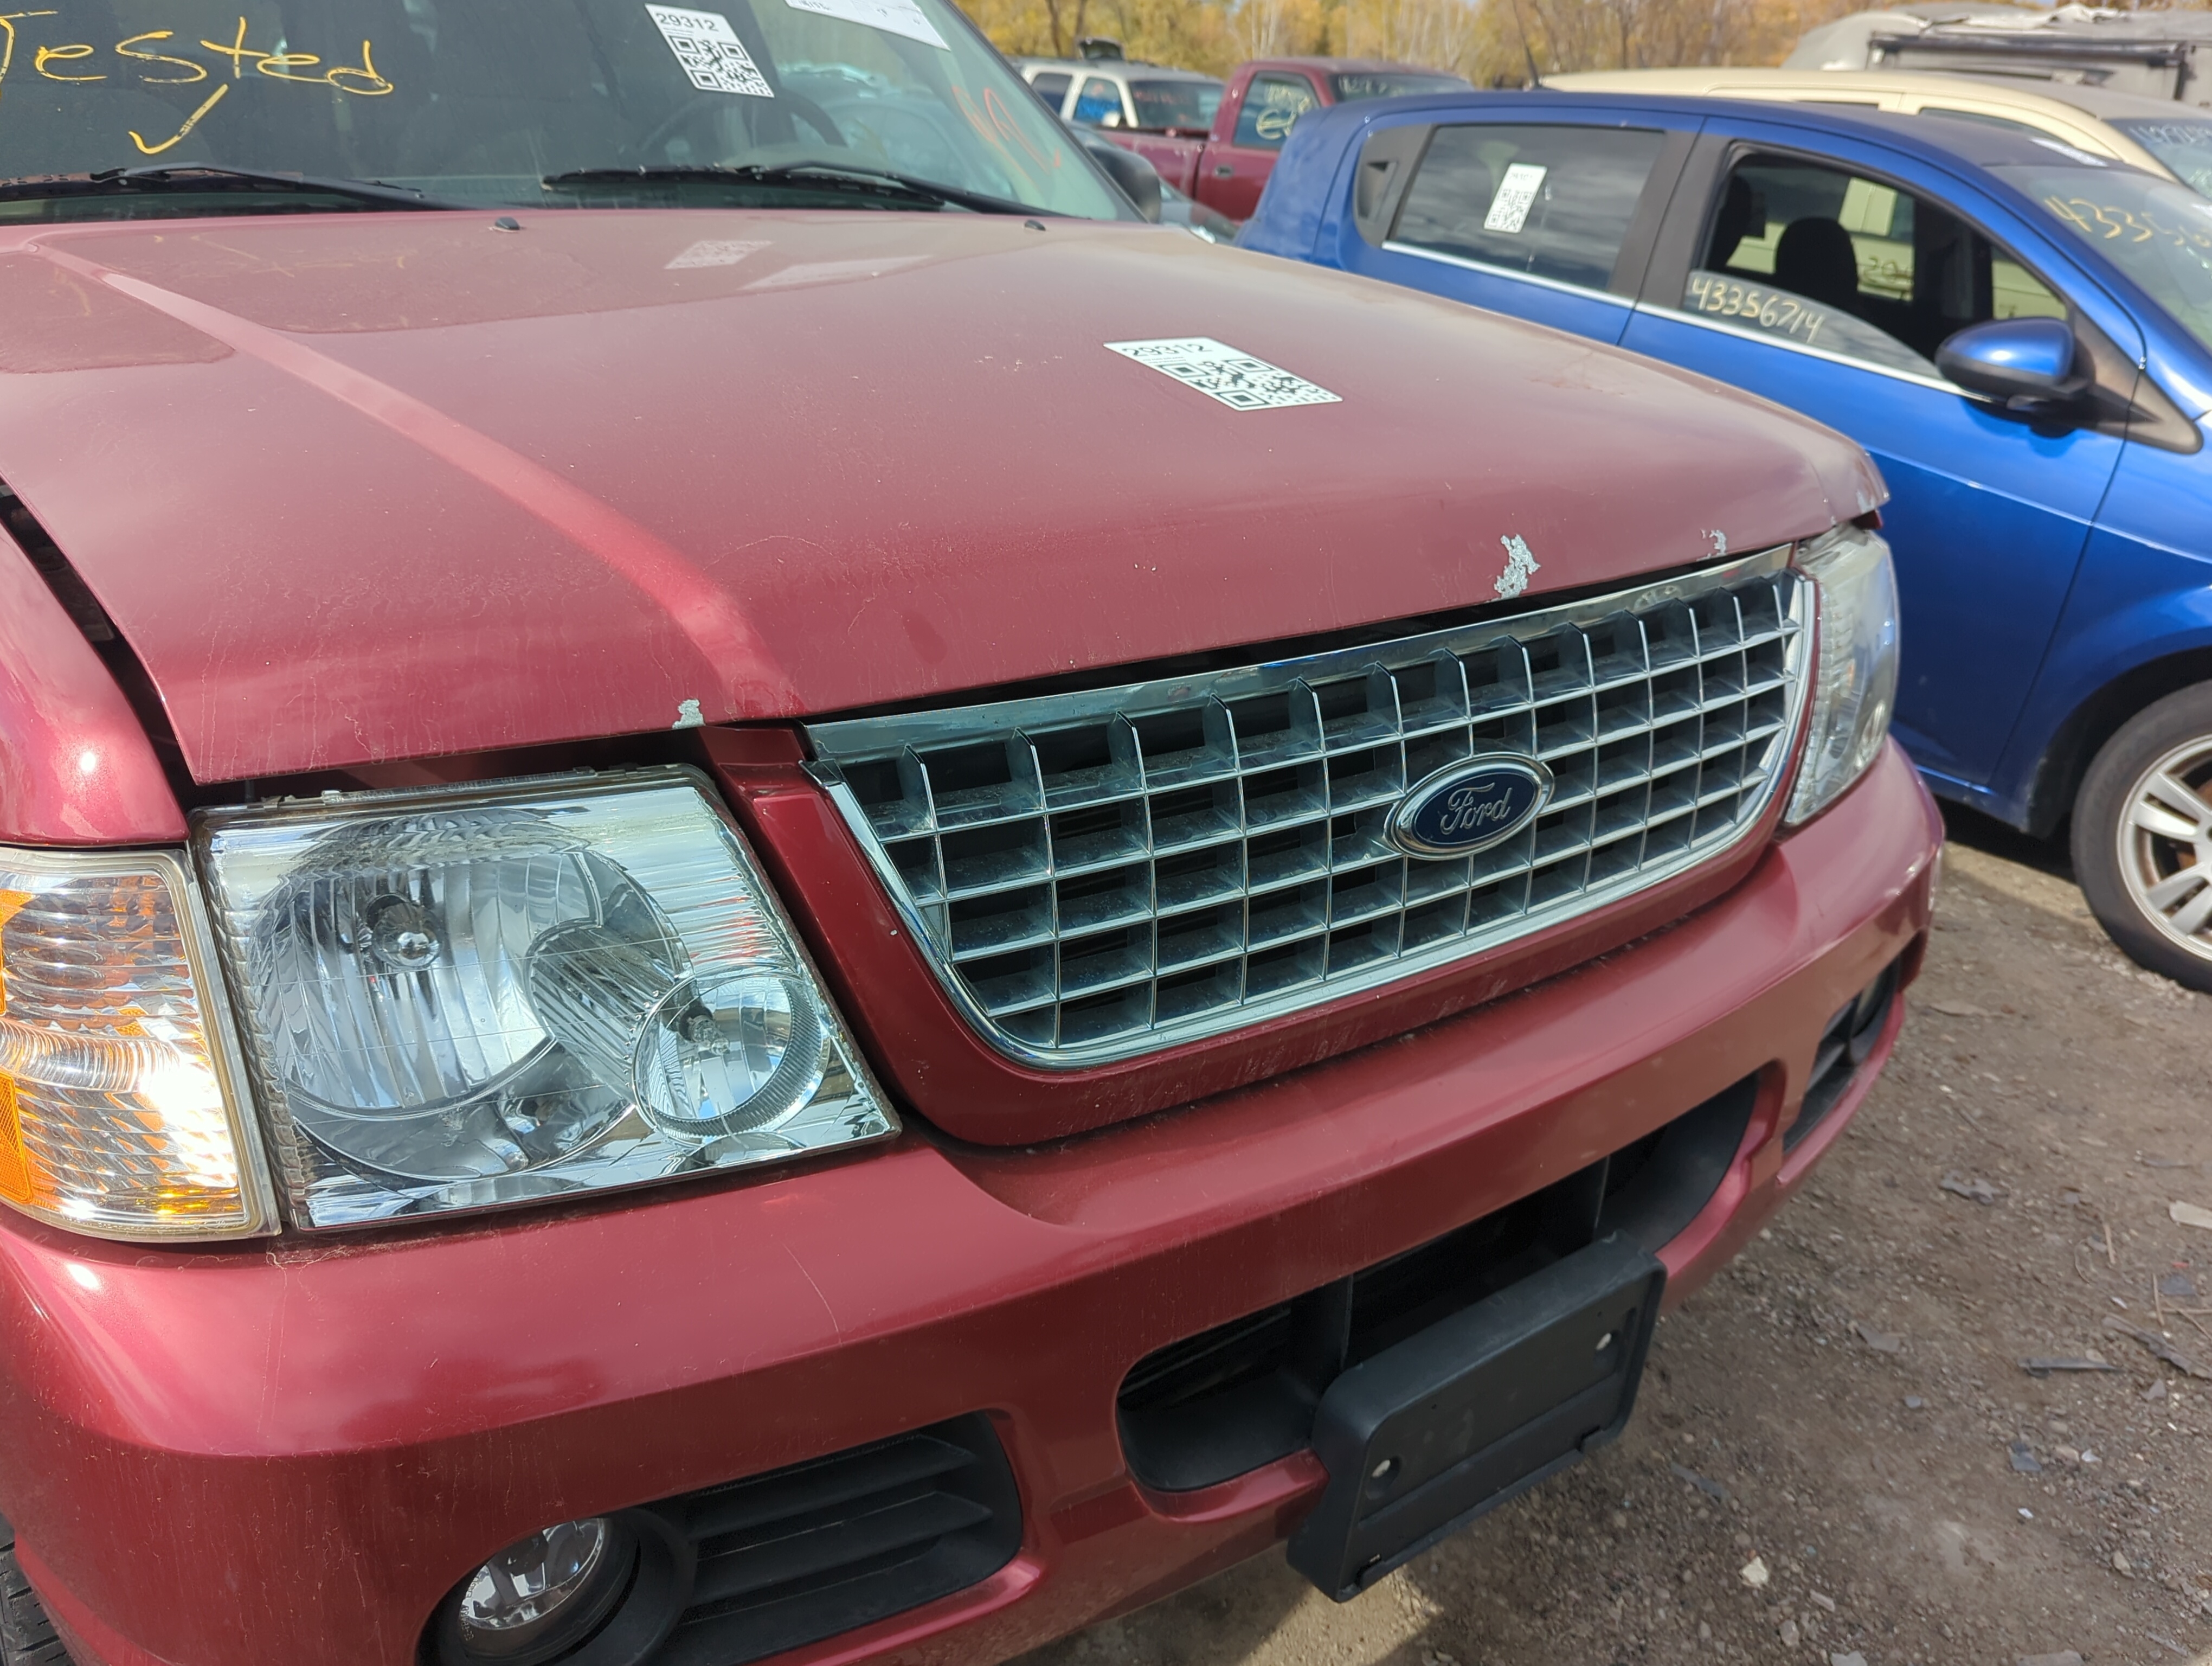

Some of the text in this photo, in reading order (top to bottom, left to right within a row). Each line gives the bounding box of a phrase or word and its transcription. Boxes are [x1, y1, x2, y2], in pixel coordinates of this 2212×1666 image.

[655, 12, 720, 32] 29312
[1692, 277, 1825, 343] 43356714
[1122, 343, 1213, 357] 29312
[1439, 781, 1513, 835] Ford
